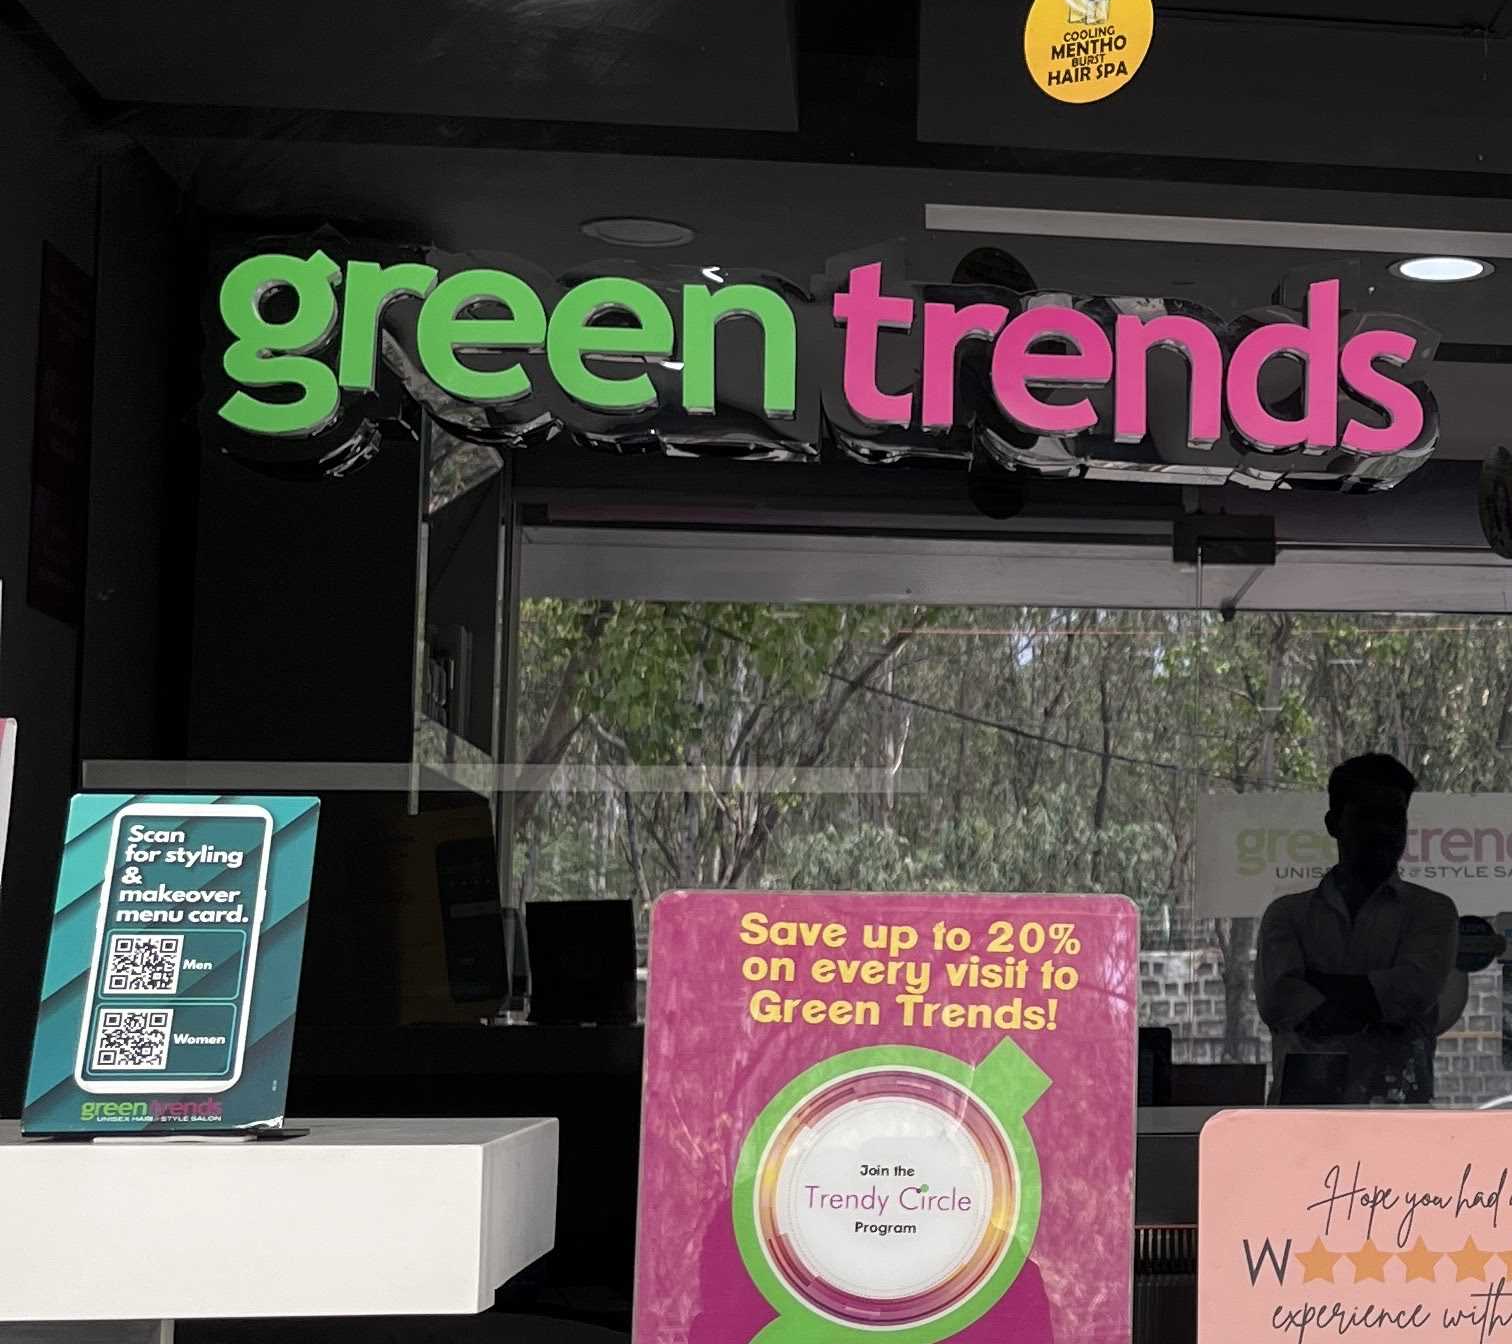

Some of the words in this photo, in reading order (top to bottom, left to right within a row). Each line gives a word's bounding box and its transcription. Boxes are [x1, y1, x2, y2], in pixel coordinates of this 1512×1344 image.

[1064, 26, 1115, 43] COOLING
[1051, 35, 1127, 60] MENTHO
[1072, 54, 1105, 67] BURST
[1048, 66, 1091, 86] HAIR
[1096, 61, 1128, 80] SPA
[217, 248, 796, 438] green
[833, 259, 1421, 455] trends
[128, 824, 185, 843] Scan
[125, 844, 161, 863] for
[165, 845, 243, 868] styling
[121, 866, 142, 885] &
[1424, 866, 1489, 878] STYLE
[119, 884, 240, 903] makeover
[116, 908, 184, 923] menu
[188, 904, 249, 923] card.
[739, 912, 848, 950] Save
[863, 923, 918, 956] up
[932, 921, 972, 953] to
[986, 920, 1082, 955] 20%
[182, 959, 213, 971] Men
[741, 957, 796, 983] on
[811, 959, 931, 995] every
[946, 956, 1028, 989] visit
[1040, 960, 1080, 991] to
[749, 989, 881, 1026] Green
[896, 993, 1059, 1031] Trends!
[173, 1033, 226, 1045] Women
[80, 1100, 148, 1122] green
[860, 1164, 890, 1177] Join
[894, 1165, 915, 1177] the
[805, 1185, 889, 1216] Trendy
[899, 1184, 972, 1212] Circle
[1307, 1160, 1398, 1240] Hope
[1396, 1190, 1452, 1248] you
[1455, 1163, 1510, 1228] had
[854, 1221, 917, 1236] Program
